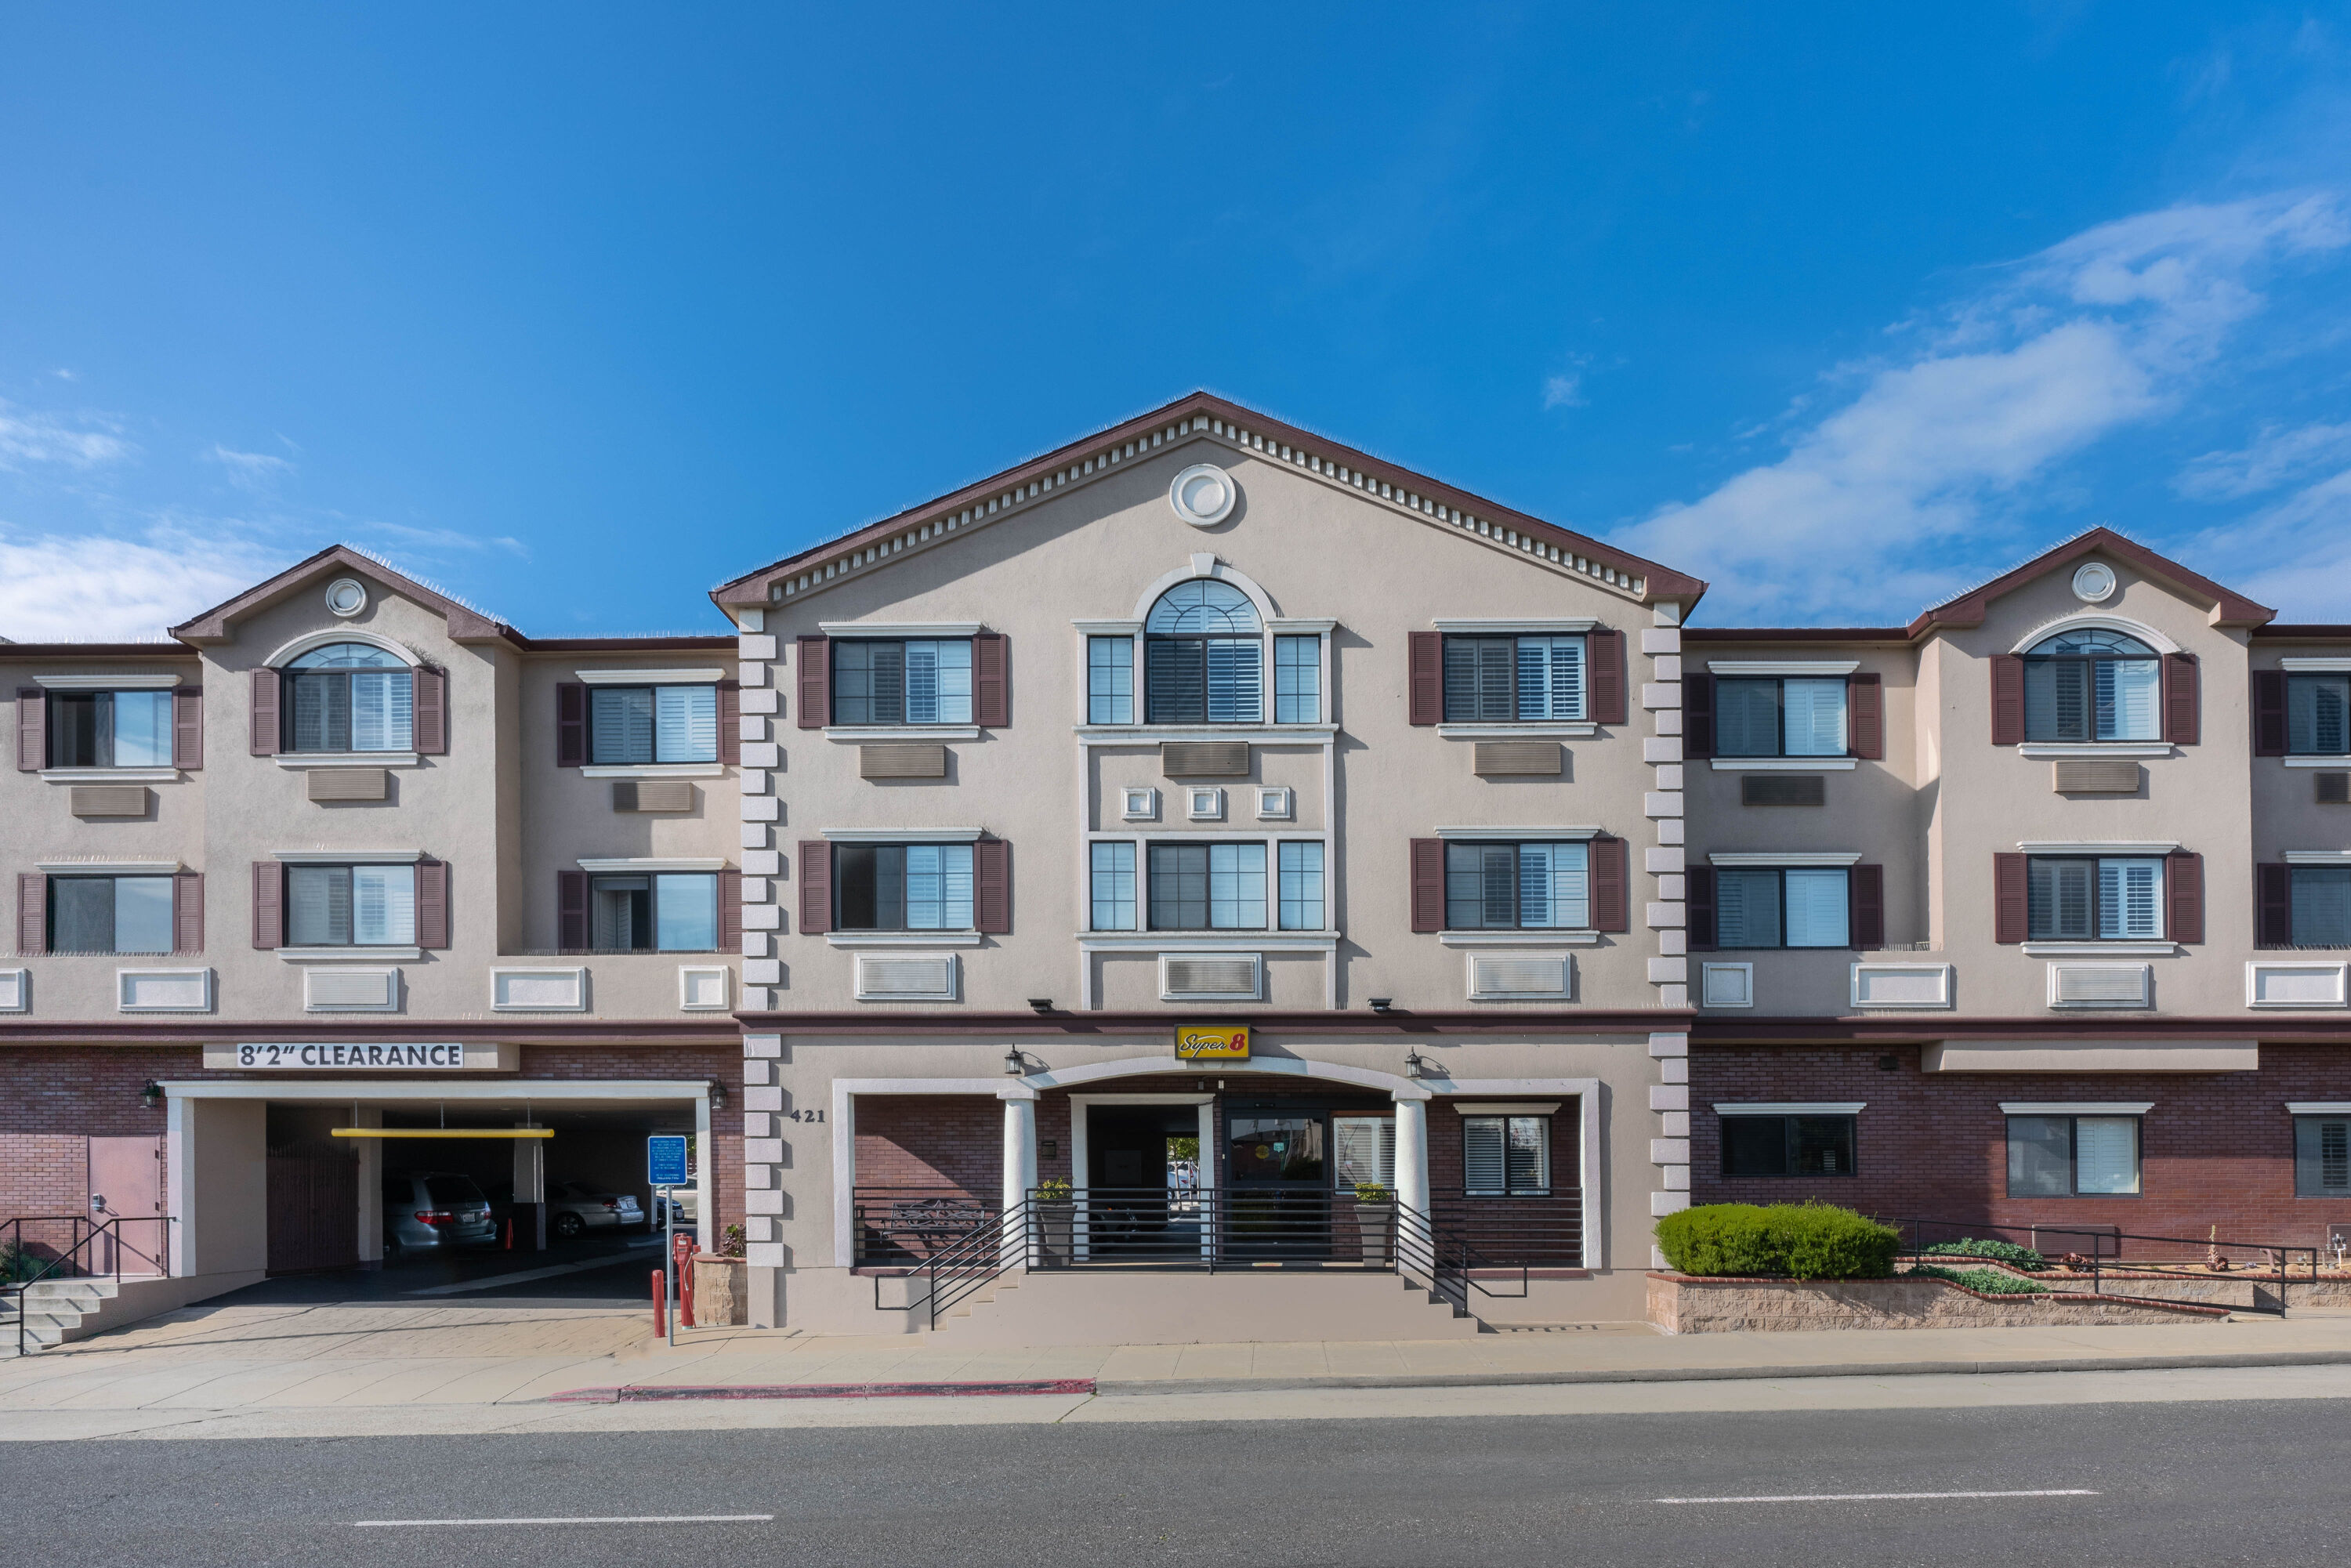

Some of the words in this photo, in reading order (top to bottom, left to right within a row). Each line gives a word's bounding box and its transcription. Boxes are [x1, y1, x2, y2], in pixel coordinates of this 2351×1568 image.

[301, 1045, 460, 1066] CLEARANCE
[1179, 1034, 1227, 1057] Super
[1229, 1034, 1245, 1052] 8
[790, 1110, 825, 1123] 421
